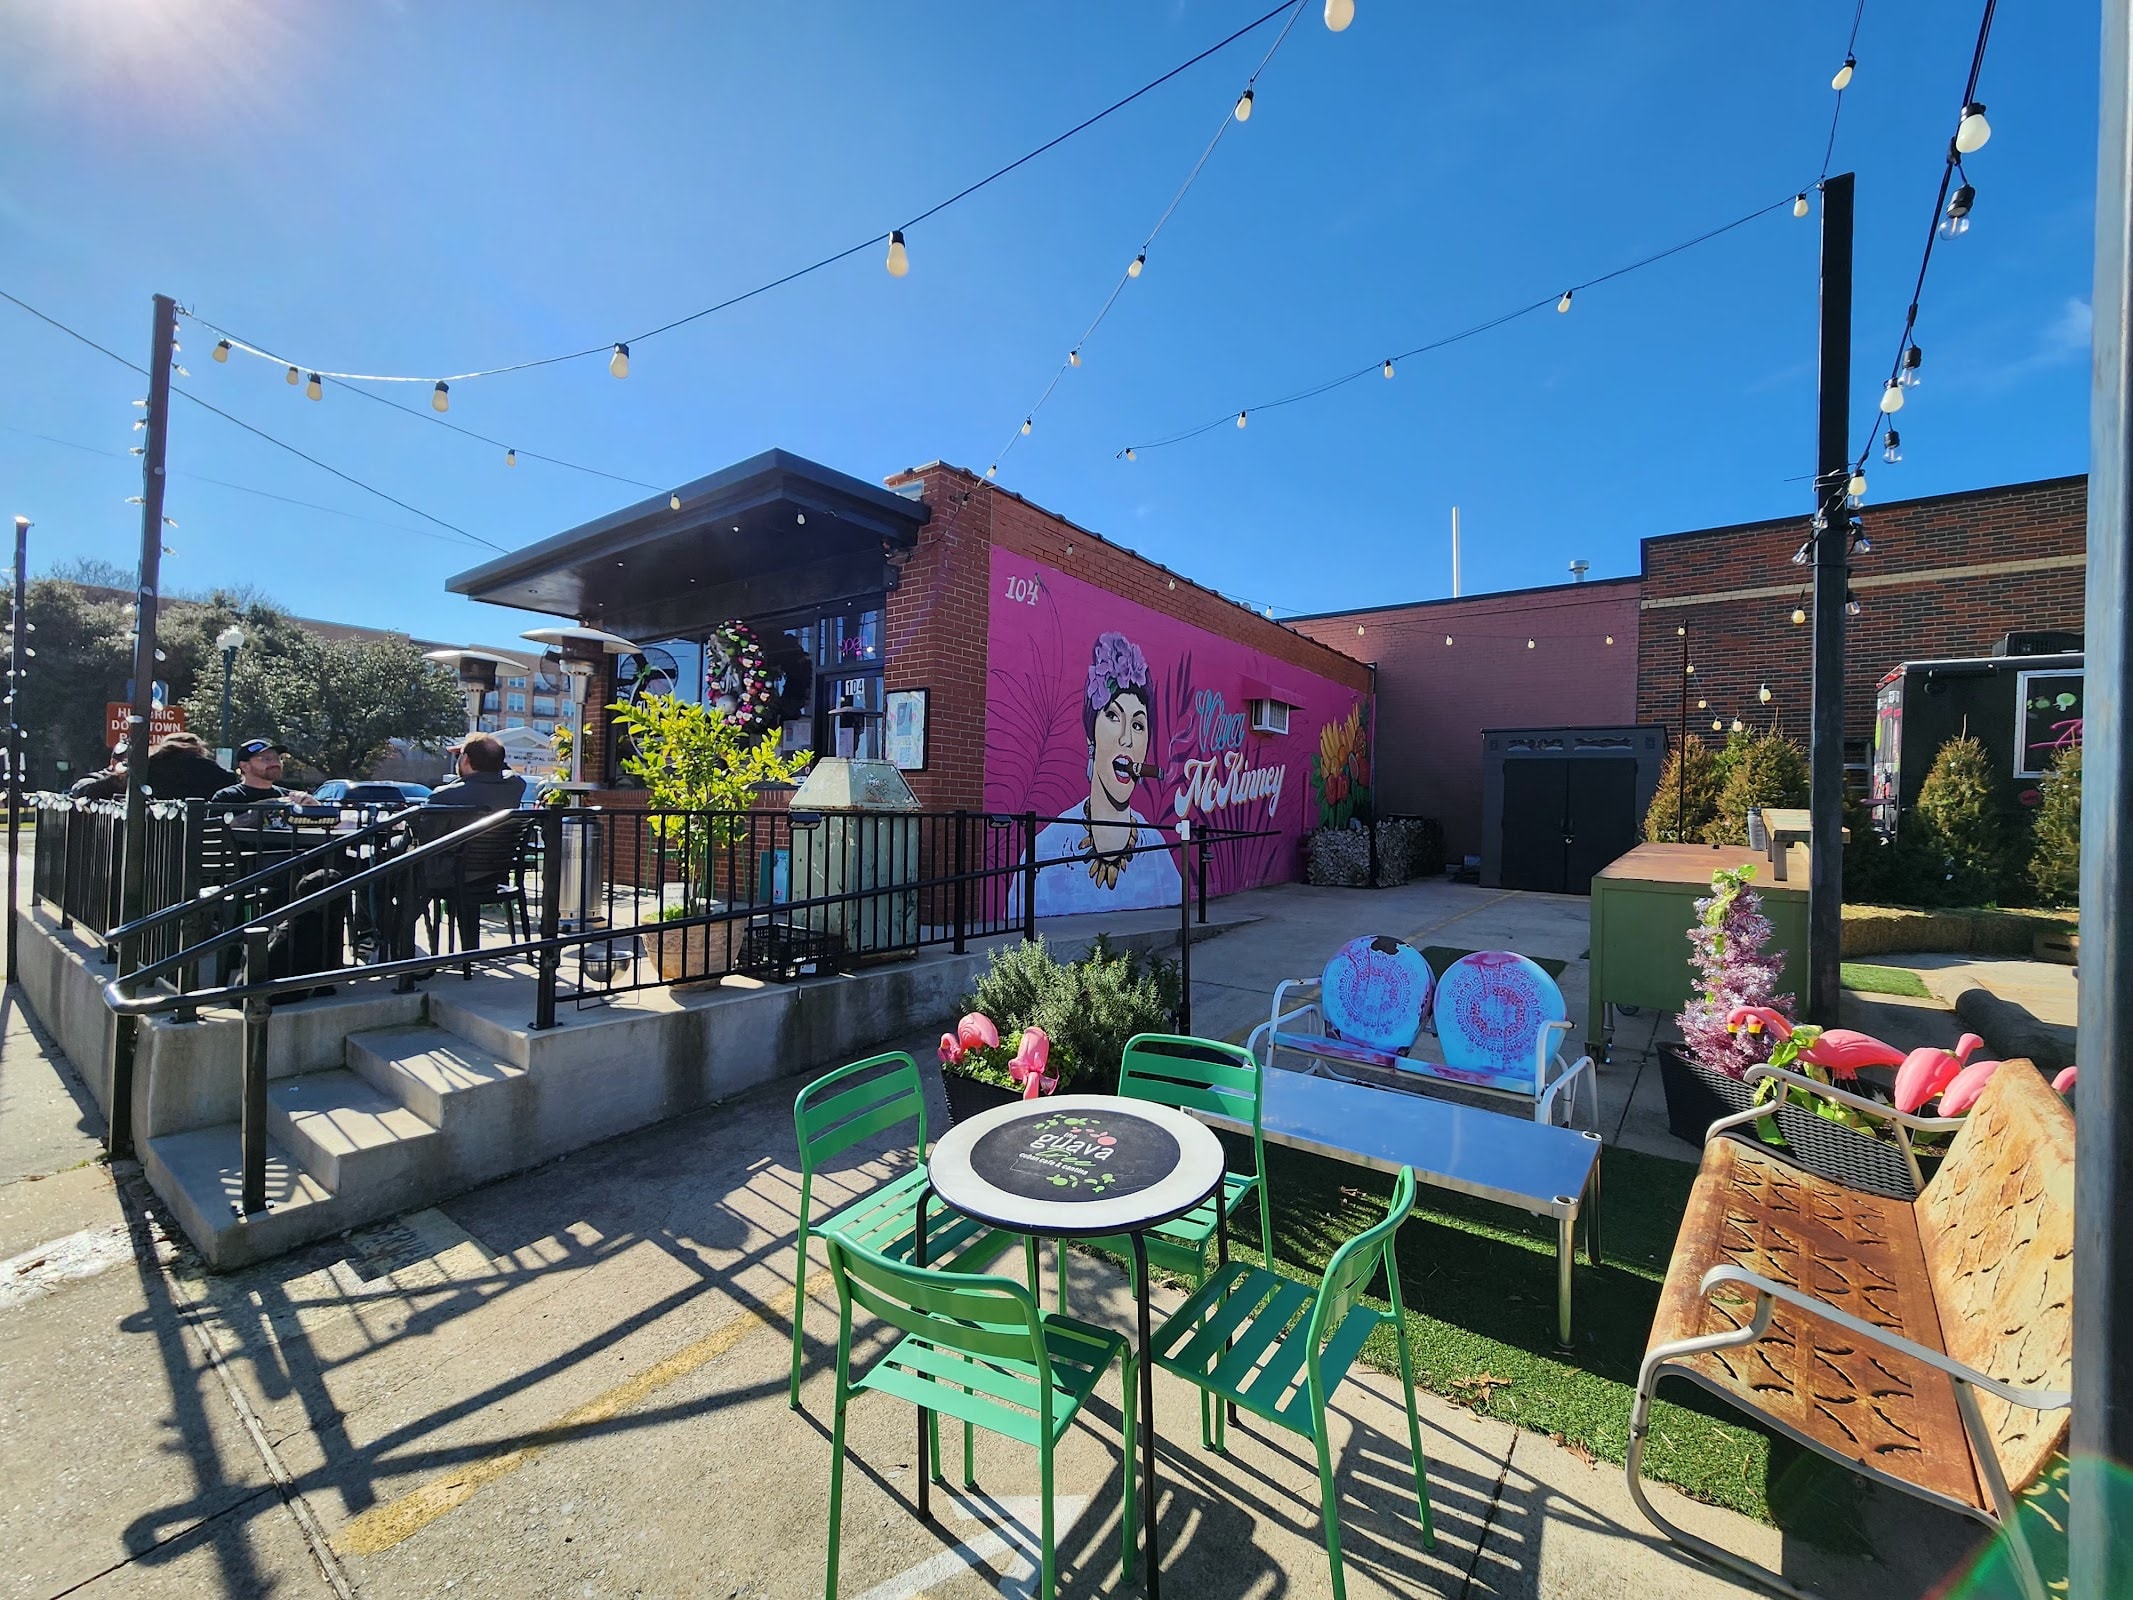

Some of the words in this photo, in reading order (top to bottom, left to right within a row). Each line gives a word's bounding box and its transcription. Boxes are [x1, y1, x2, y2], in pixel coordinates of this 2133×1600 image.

[1005, 575, 1039, 606] 104
[846, 679, 864, 695] 104
[111, 719, 181, 733] DOTOWN
[117, 707, 175, 721] HIRIC
[1195, 689, 1246, 753] Viva
[1174, 750, 1286, 818] McKinney
[1030, 1133, 1115, 1161] guava
